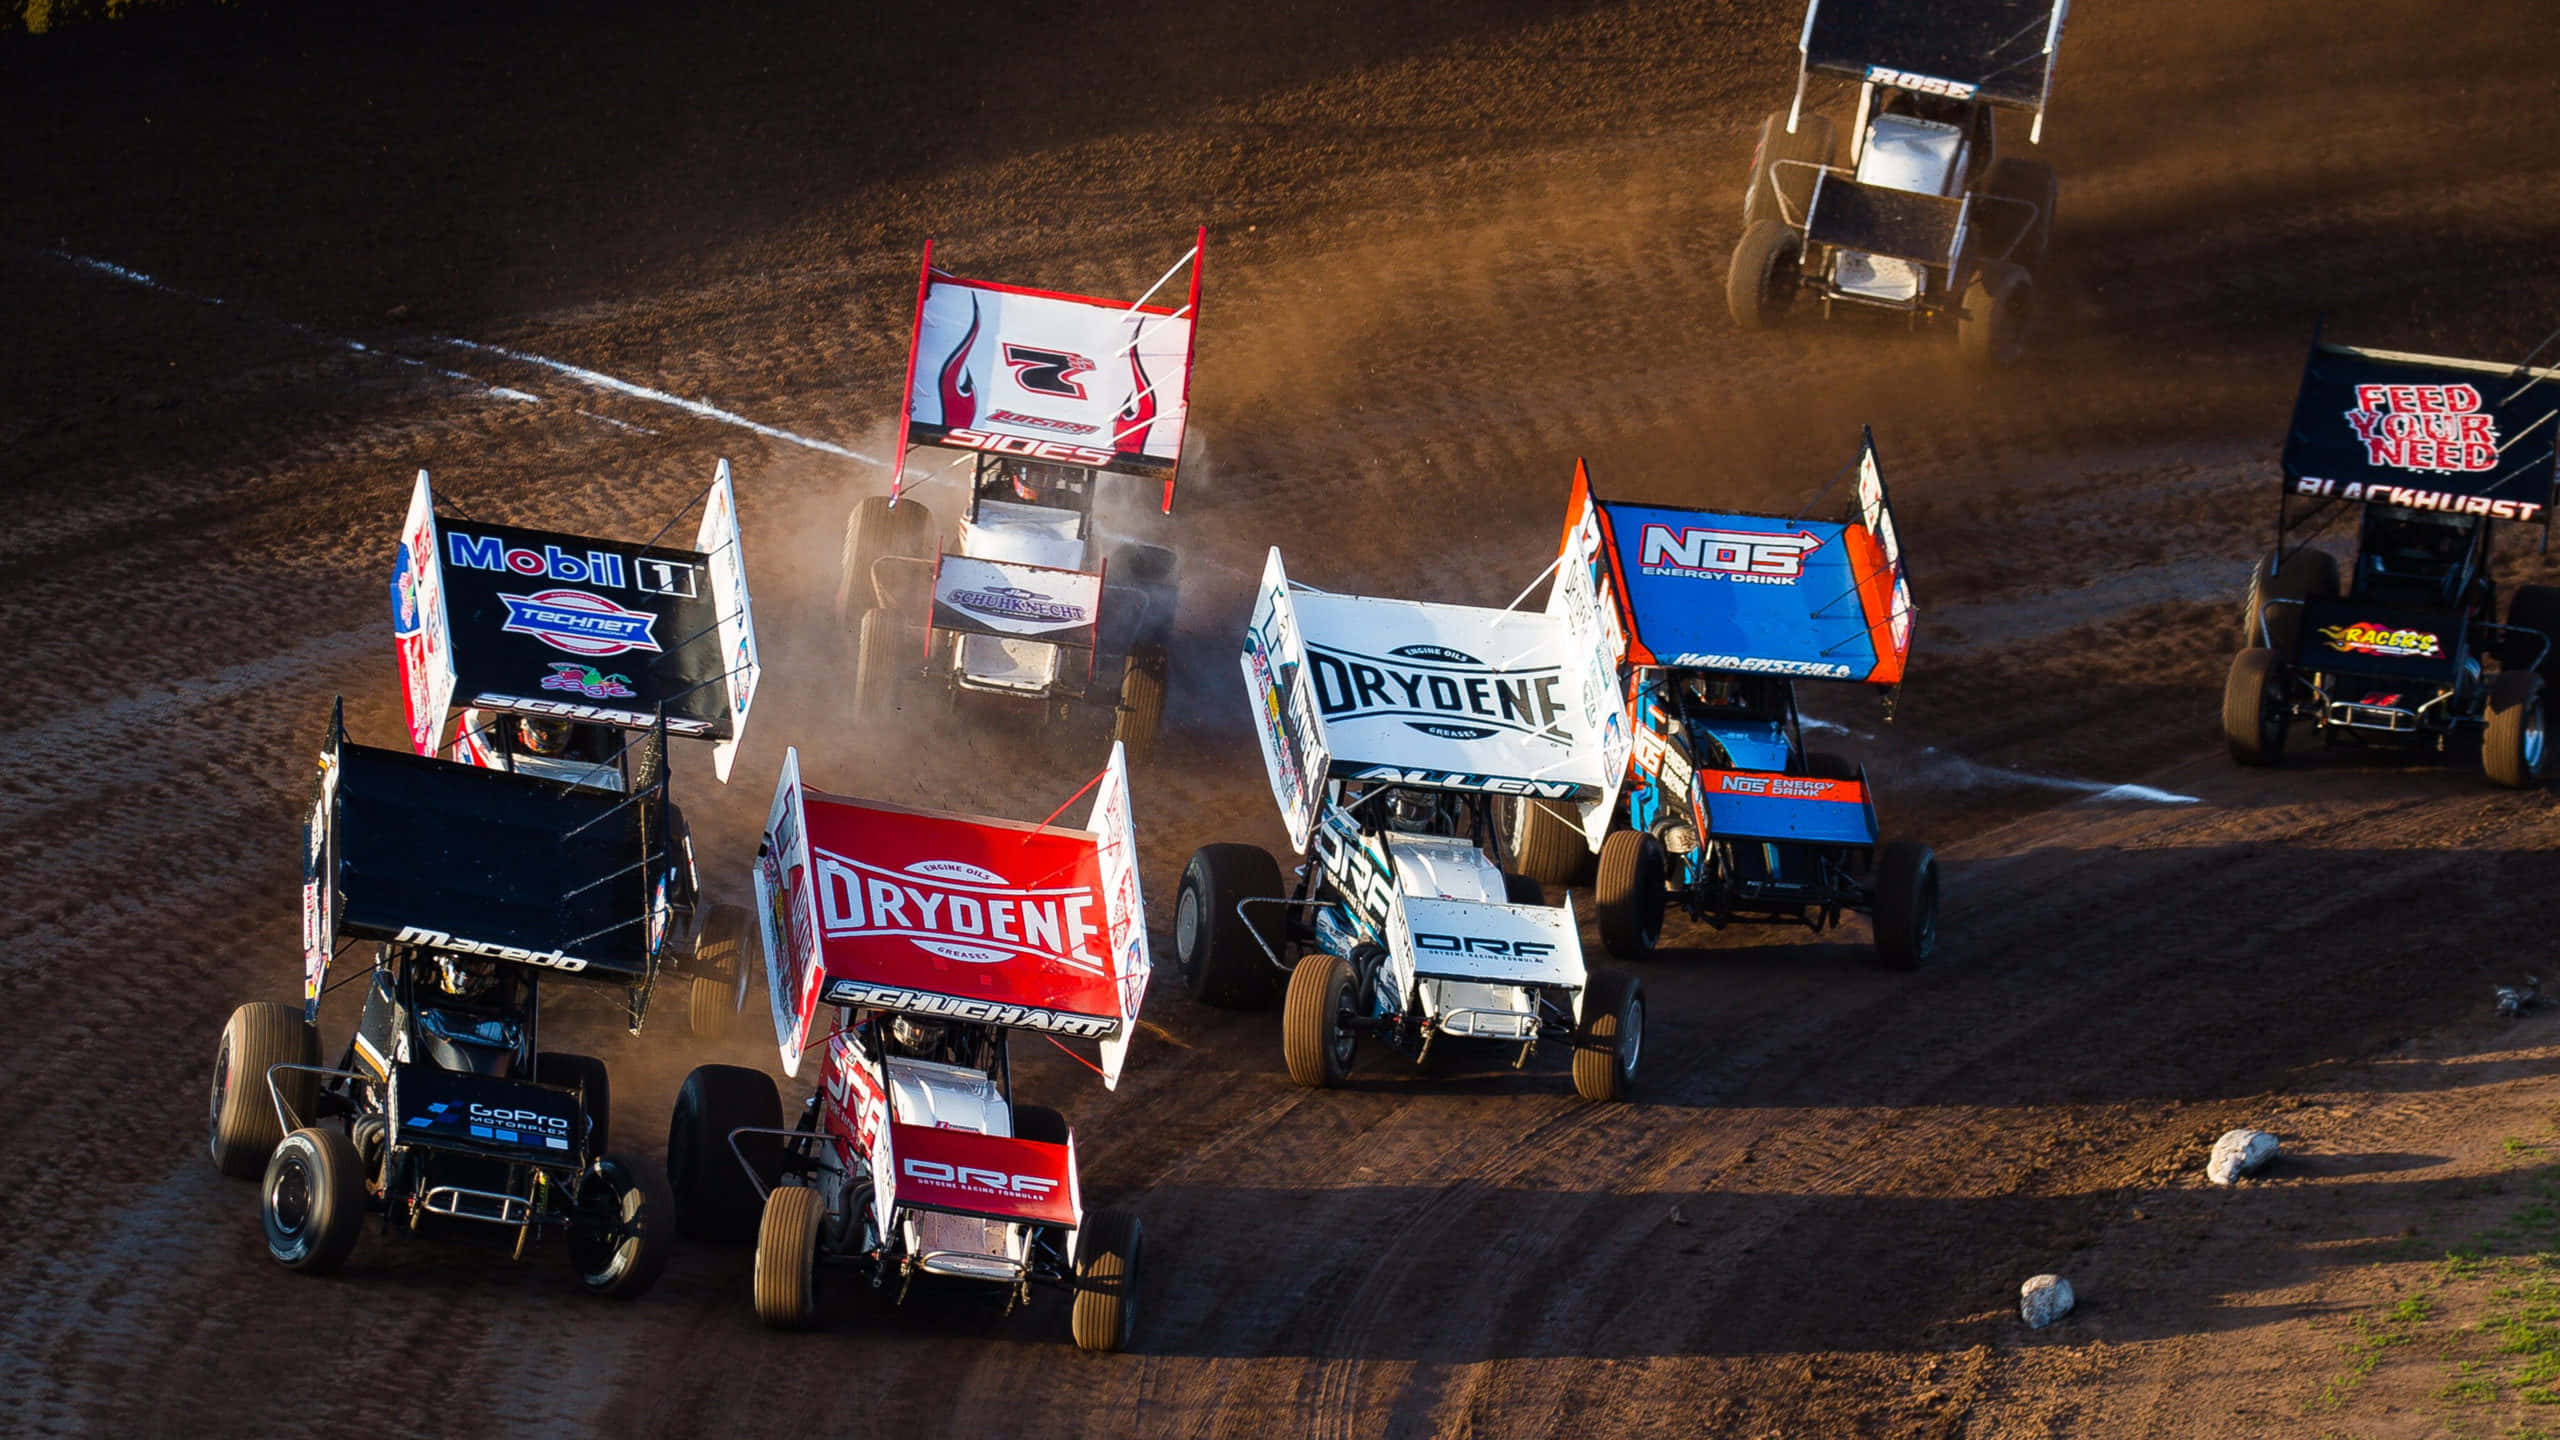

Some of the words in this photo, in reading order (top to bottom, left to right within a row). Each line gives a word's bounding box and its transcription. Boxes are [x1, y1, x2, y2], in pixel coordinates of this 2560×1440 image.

[1868, 66, 1975, 100] ROSE
[2354, 384, 2482, 413] FEED
[2345, 409, 2496, 444] YOUR
[940, 427, 1117, 466] SIDES
[2365, 438, 2499, 472] NEED
[2297, 477, 2541, 521] BLACKHURST
[448, 532, 625, 588] Mobil
[1641, 524, 1822, 576] NOS
[1642, 567, 1724, 581] ENERGY
[1730, 574, 1795, 585] DRINK
[948, 589, 1087, 621] SCHUHKNECHT
[1405, 646, 1441, 657] ENGINE
[1443, 648, 1468, 662] OILS
[2345, 628, 2435, 651] RACER'S
[1673, 653, 1850, 679] HAUDENSCHILD
[1306, 649, 1573, 740] DRYDENE
[1429, 727, 1477, 739] GREASES
[1353, 766, 1574, 798] ALLEN
[1722, 775, 1770, 793] NOS
[1773, 779, 1835, 789] ENERGY
[1772, 788, 1820, 797] DRINK
[924, 864, 962, 874] ENGINE
[966, 867, 993, 881] OILS
[1320, 823, 1393, 919] DRF
[816, 859, 1103, 966] DRYDENE
[937, 946, 990, 960] GREASES
[1414, 933, 1555, 956] DRF
[832, 981, 1116, 1037] SCHUCHART
[470, 1103, 568, 1128] GoPro
[470, 1116, 567, 1136] MOTORPLEX
[904, 1158, 1058, 1192] DRF
[961, 1186, 994, 1194] RACING
[998, 1190, 1043, 1200] FORMULAS
